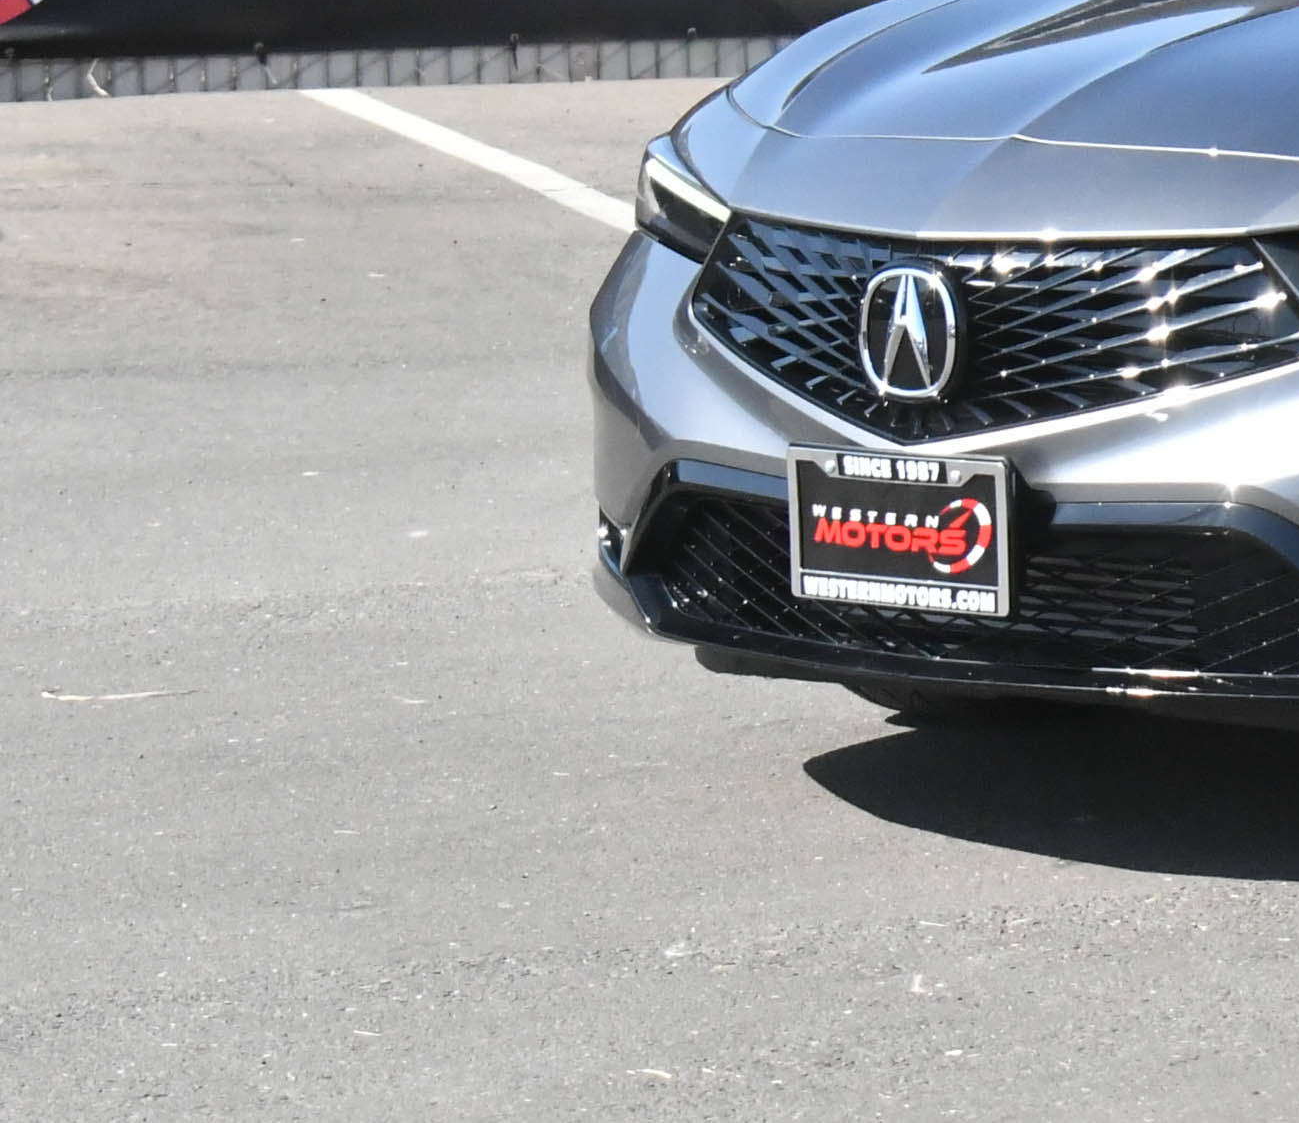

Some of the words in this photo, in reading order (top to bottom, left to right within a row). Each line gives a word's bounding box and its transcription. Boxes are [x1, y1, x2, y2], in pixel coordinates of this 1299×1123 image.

[842, 455, 893, 479] SINCE
[896, 459, 941, 481] 1987
[811, 503, 940, 529] WESTERN
[813, 516, 968, 556] MOTORS
[803, 575, 996, 613] WESTERNMOTORS.COM
